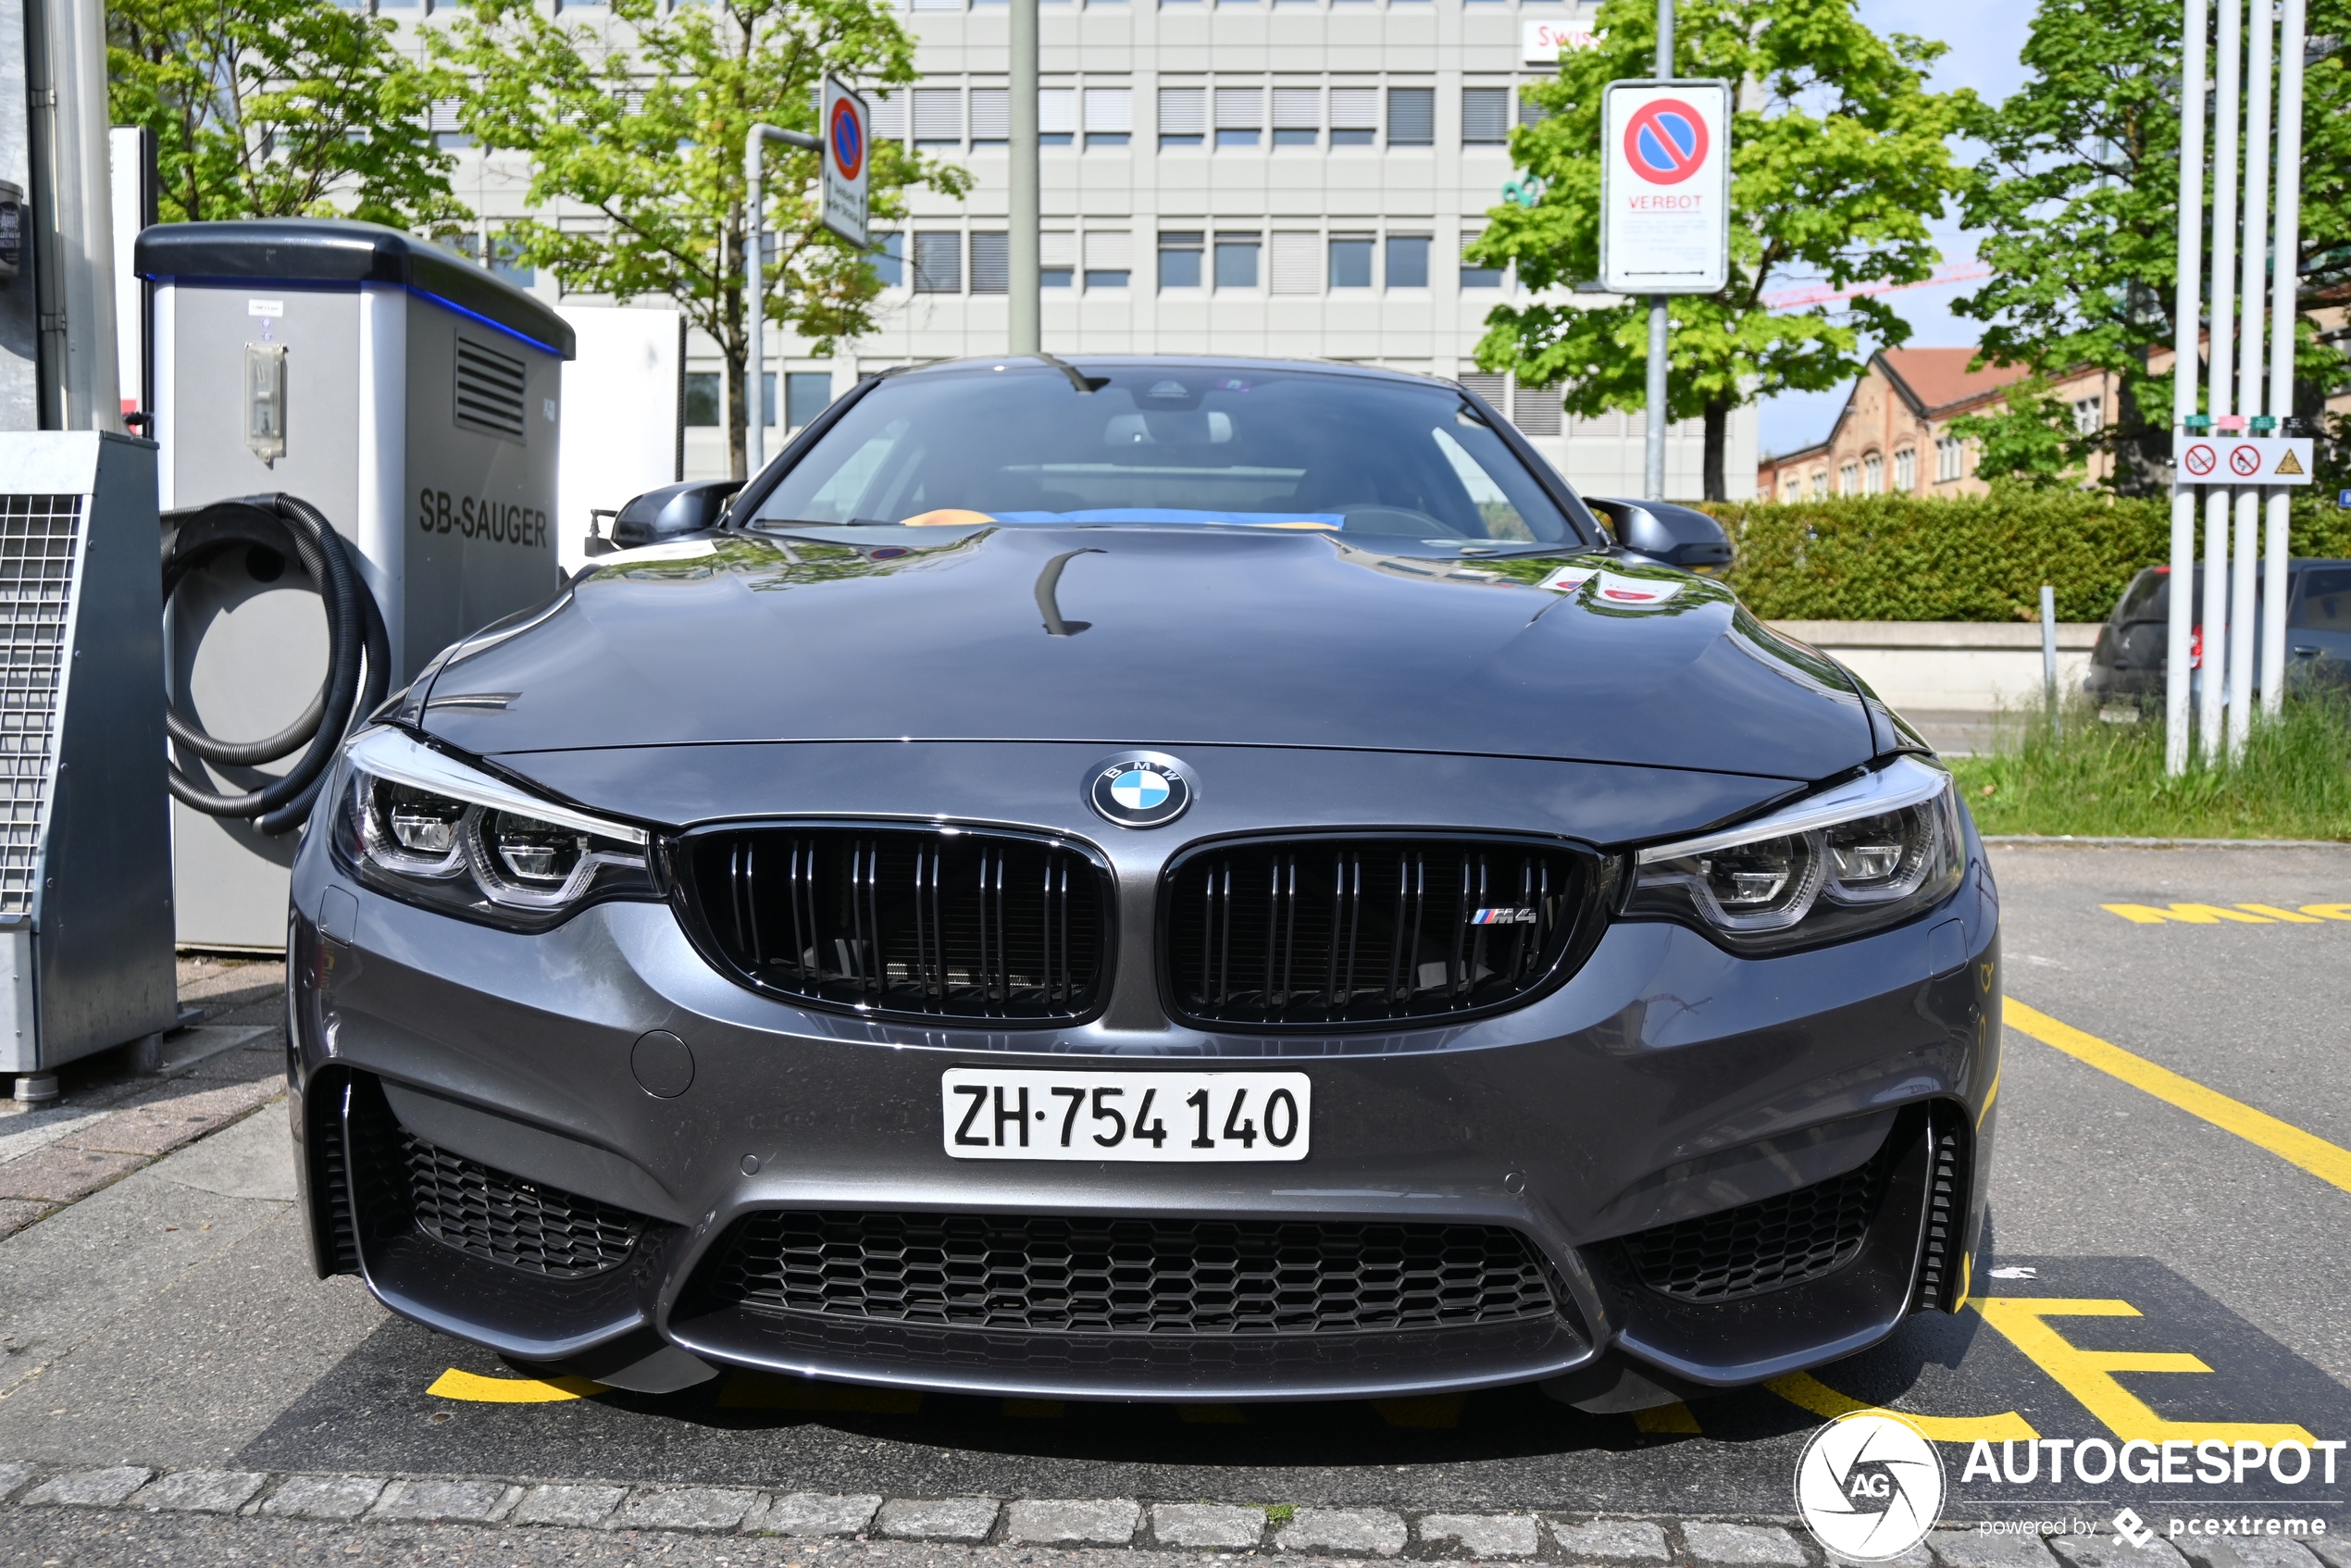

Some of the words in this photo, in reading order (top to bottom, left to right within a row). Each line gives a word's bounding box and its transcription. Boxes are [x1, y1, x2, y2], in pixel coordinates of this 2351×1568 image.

[1629, 195, 1702, 209] VERBOT
[419, 487, 547, 549] SB-SAUGER
[1104, 762, 1180, 781] BMW
[1483, 908, 1536, 924] M4
[1186, 1088, 1299, 1149] 140
